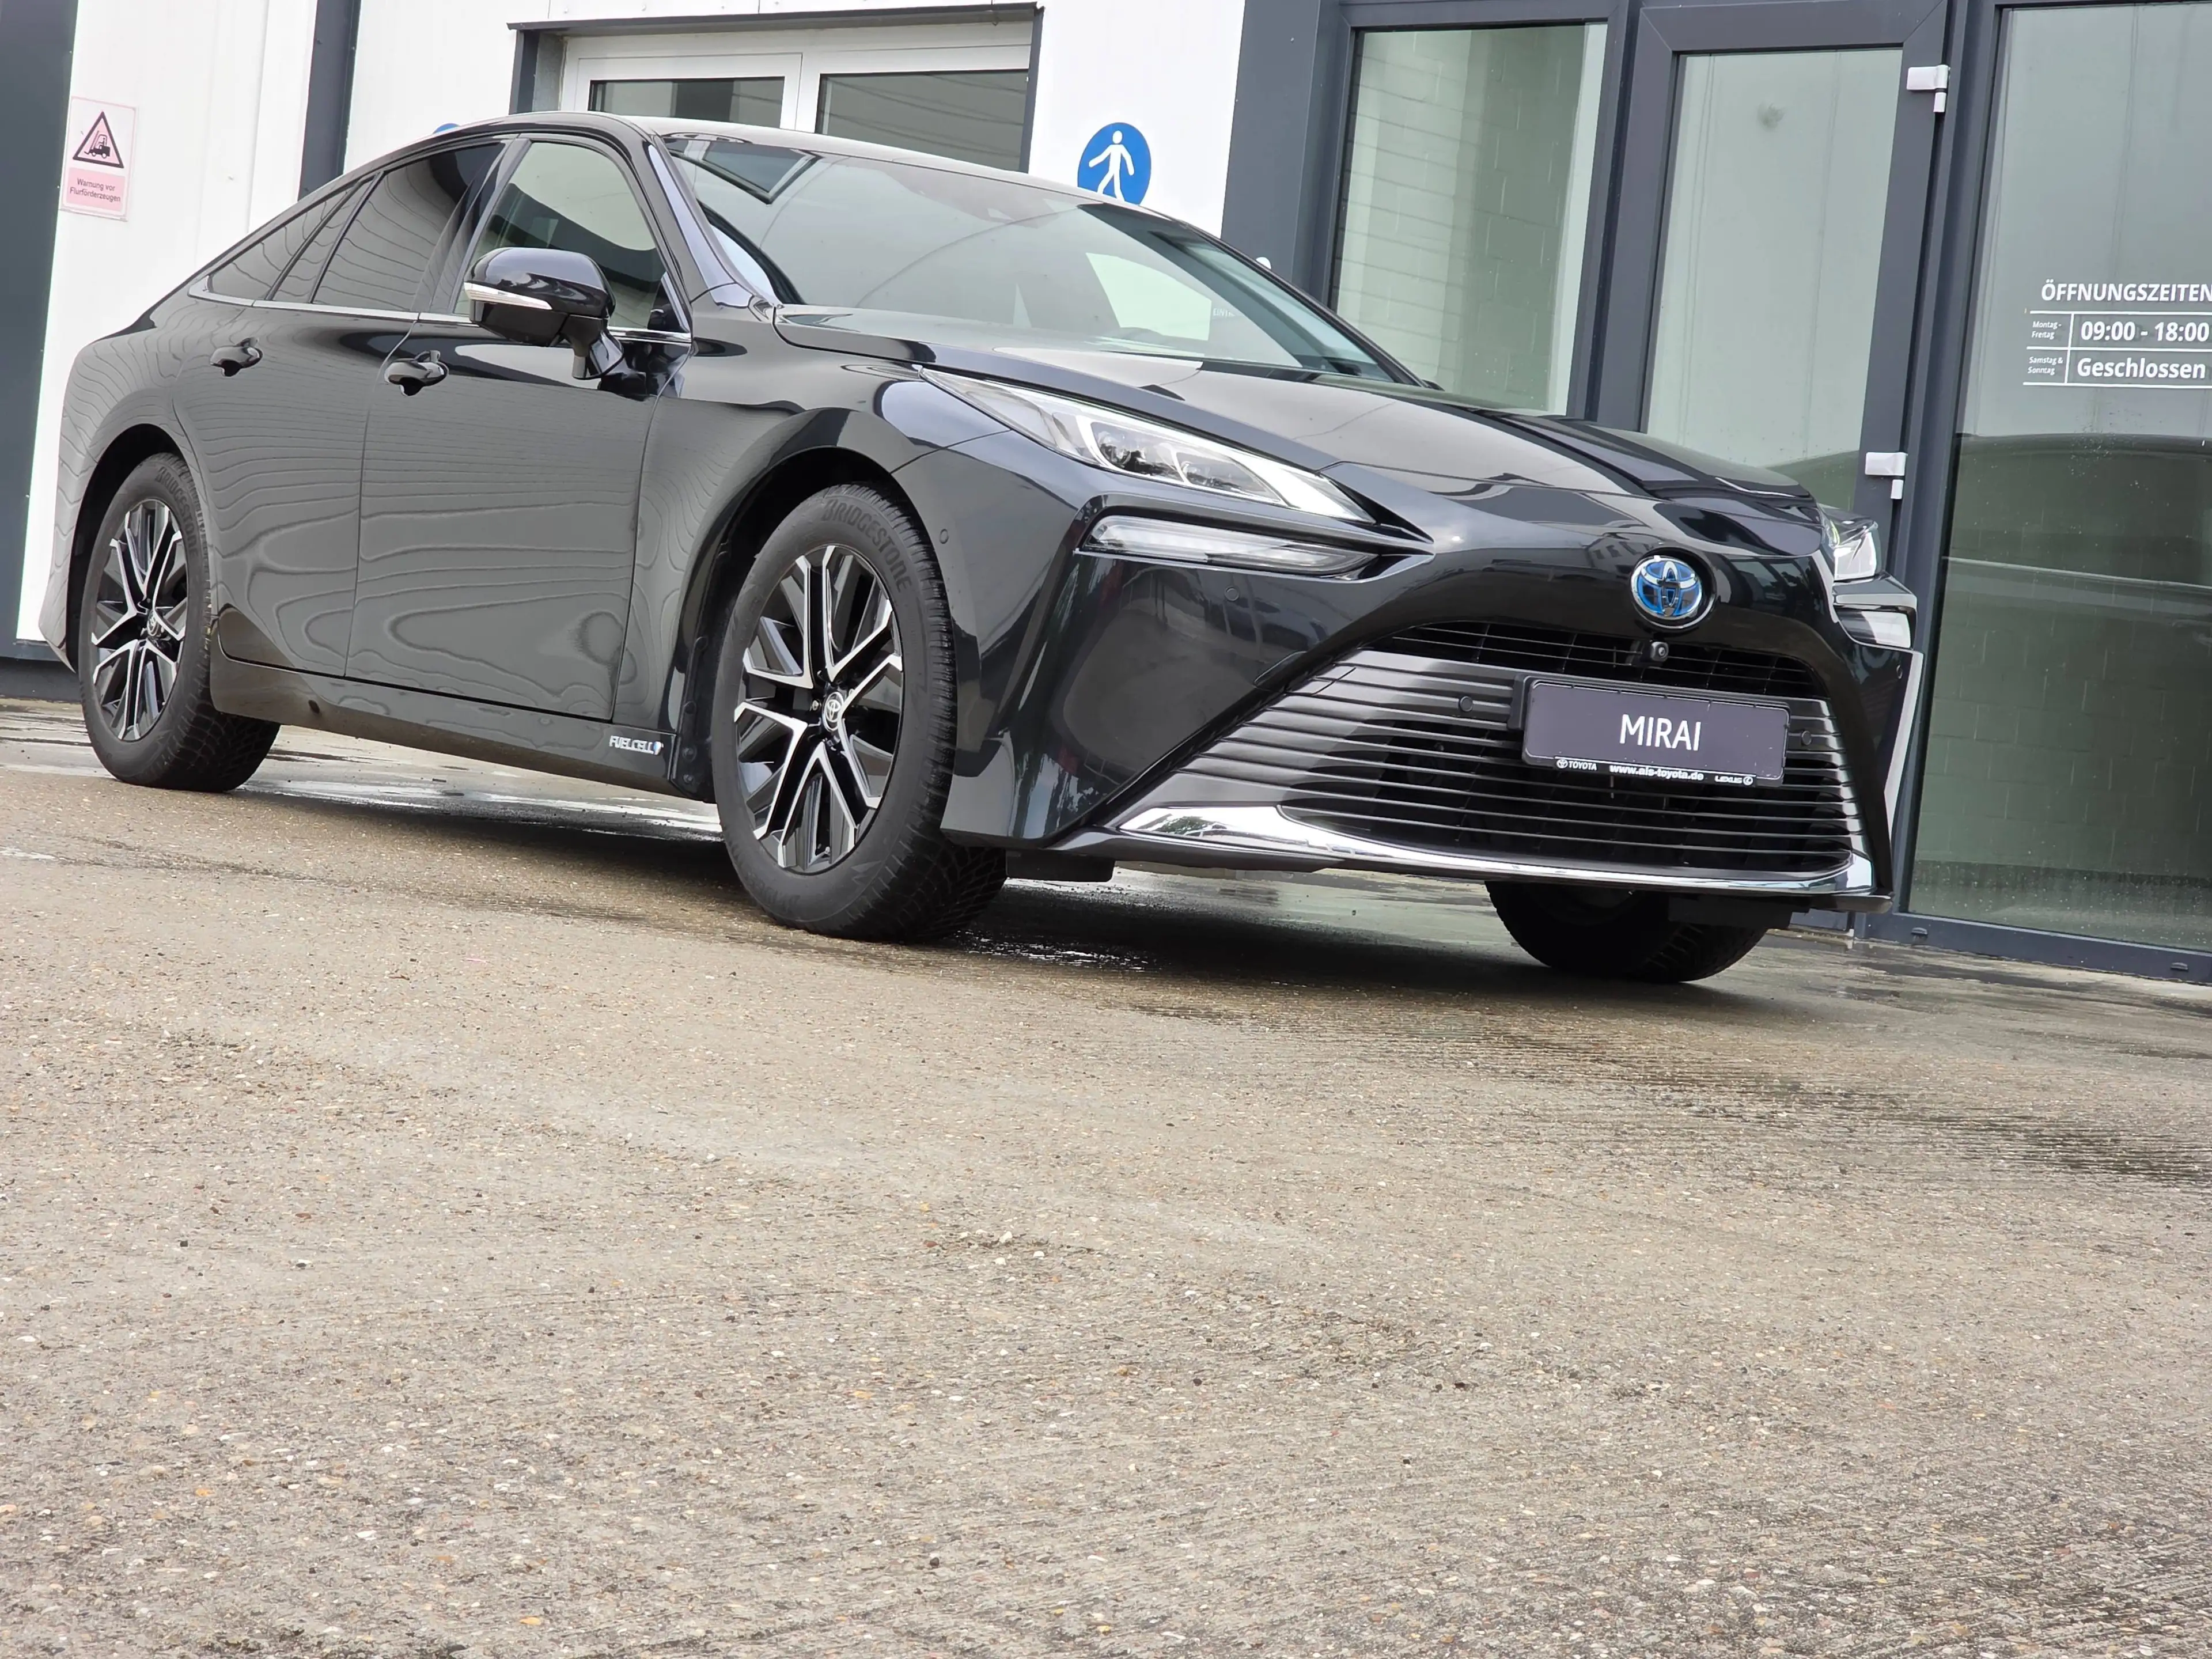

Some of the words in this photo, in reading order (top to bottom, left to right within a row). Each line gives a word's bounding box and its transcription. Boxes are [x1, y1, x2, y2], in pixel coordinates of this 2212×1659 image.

[77, 177, 104, 191] Warnung
[70, 186, 121, 202] Flurförderzeugen
[2041, 279, 2212, 302] ÖFFNUNGSZEITEN
[2032, 331, 2054, 340] Freitag
[2081, 321, 2136, 341] 09:00
[2154, 321, 2210, 342] 18:00
[2029, 356, 2057, 365] Samstag
[2077, 357, 2206, 379] Geschlossen
[2027, 366, 2055, 376] Sonntag
[155, 466, 199, 557] BRIDGESTONE
[822, 499, 912, 593] BRIDGESTONE
[1619, 714, 1702, 751] MIRAI
[1569, 761, 1597, 771] TOYOTA
[1714, 775, 1742, 783] LEXUS
